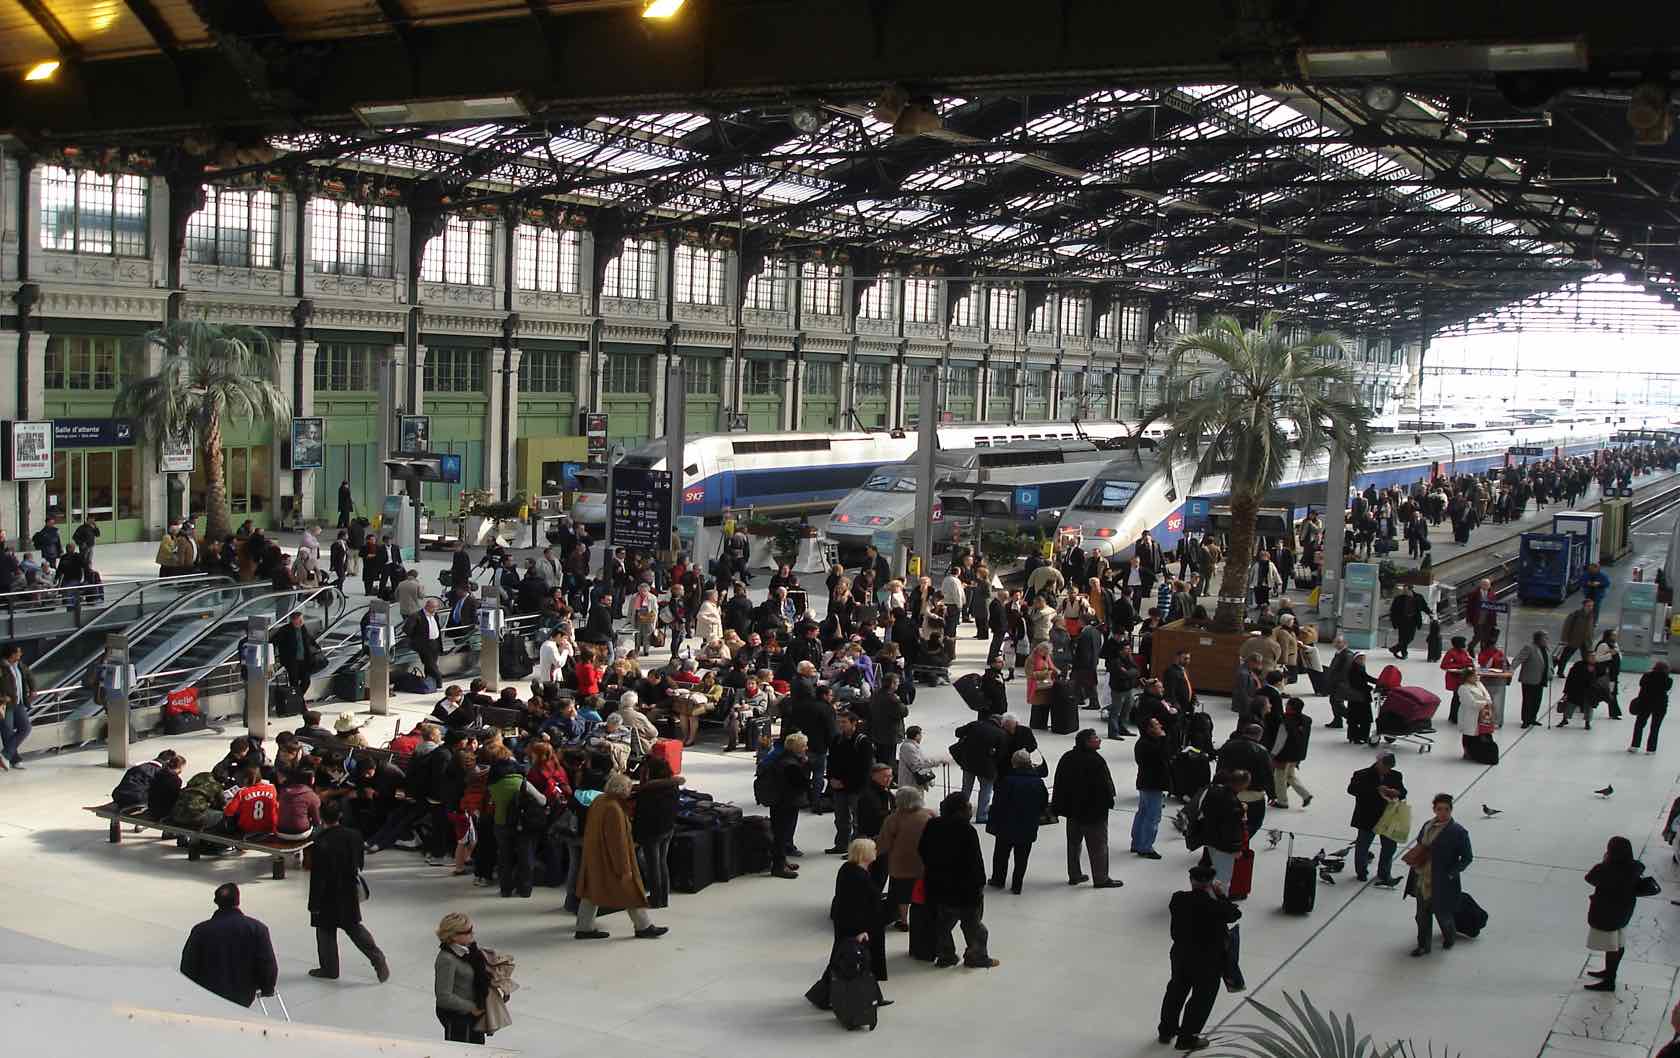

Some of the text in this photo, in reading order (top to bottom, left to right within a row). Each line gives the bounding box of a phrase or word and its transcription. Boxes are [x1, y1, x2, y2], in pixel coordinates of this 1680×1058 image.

[55, 425, 99, 434] Salle d'attente
[685, 491, 704, 502] SNCF
[1022, 492, 1032, 503] D
[1192, 503, 1200, 514] E
[1168, 519, 1182, 530] SNCF
[1480, 602, 1506, 611] Accueil
[253, 800, 264, 820] 8
